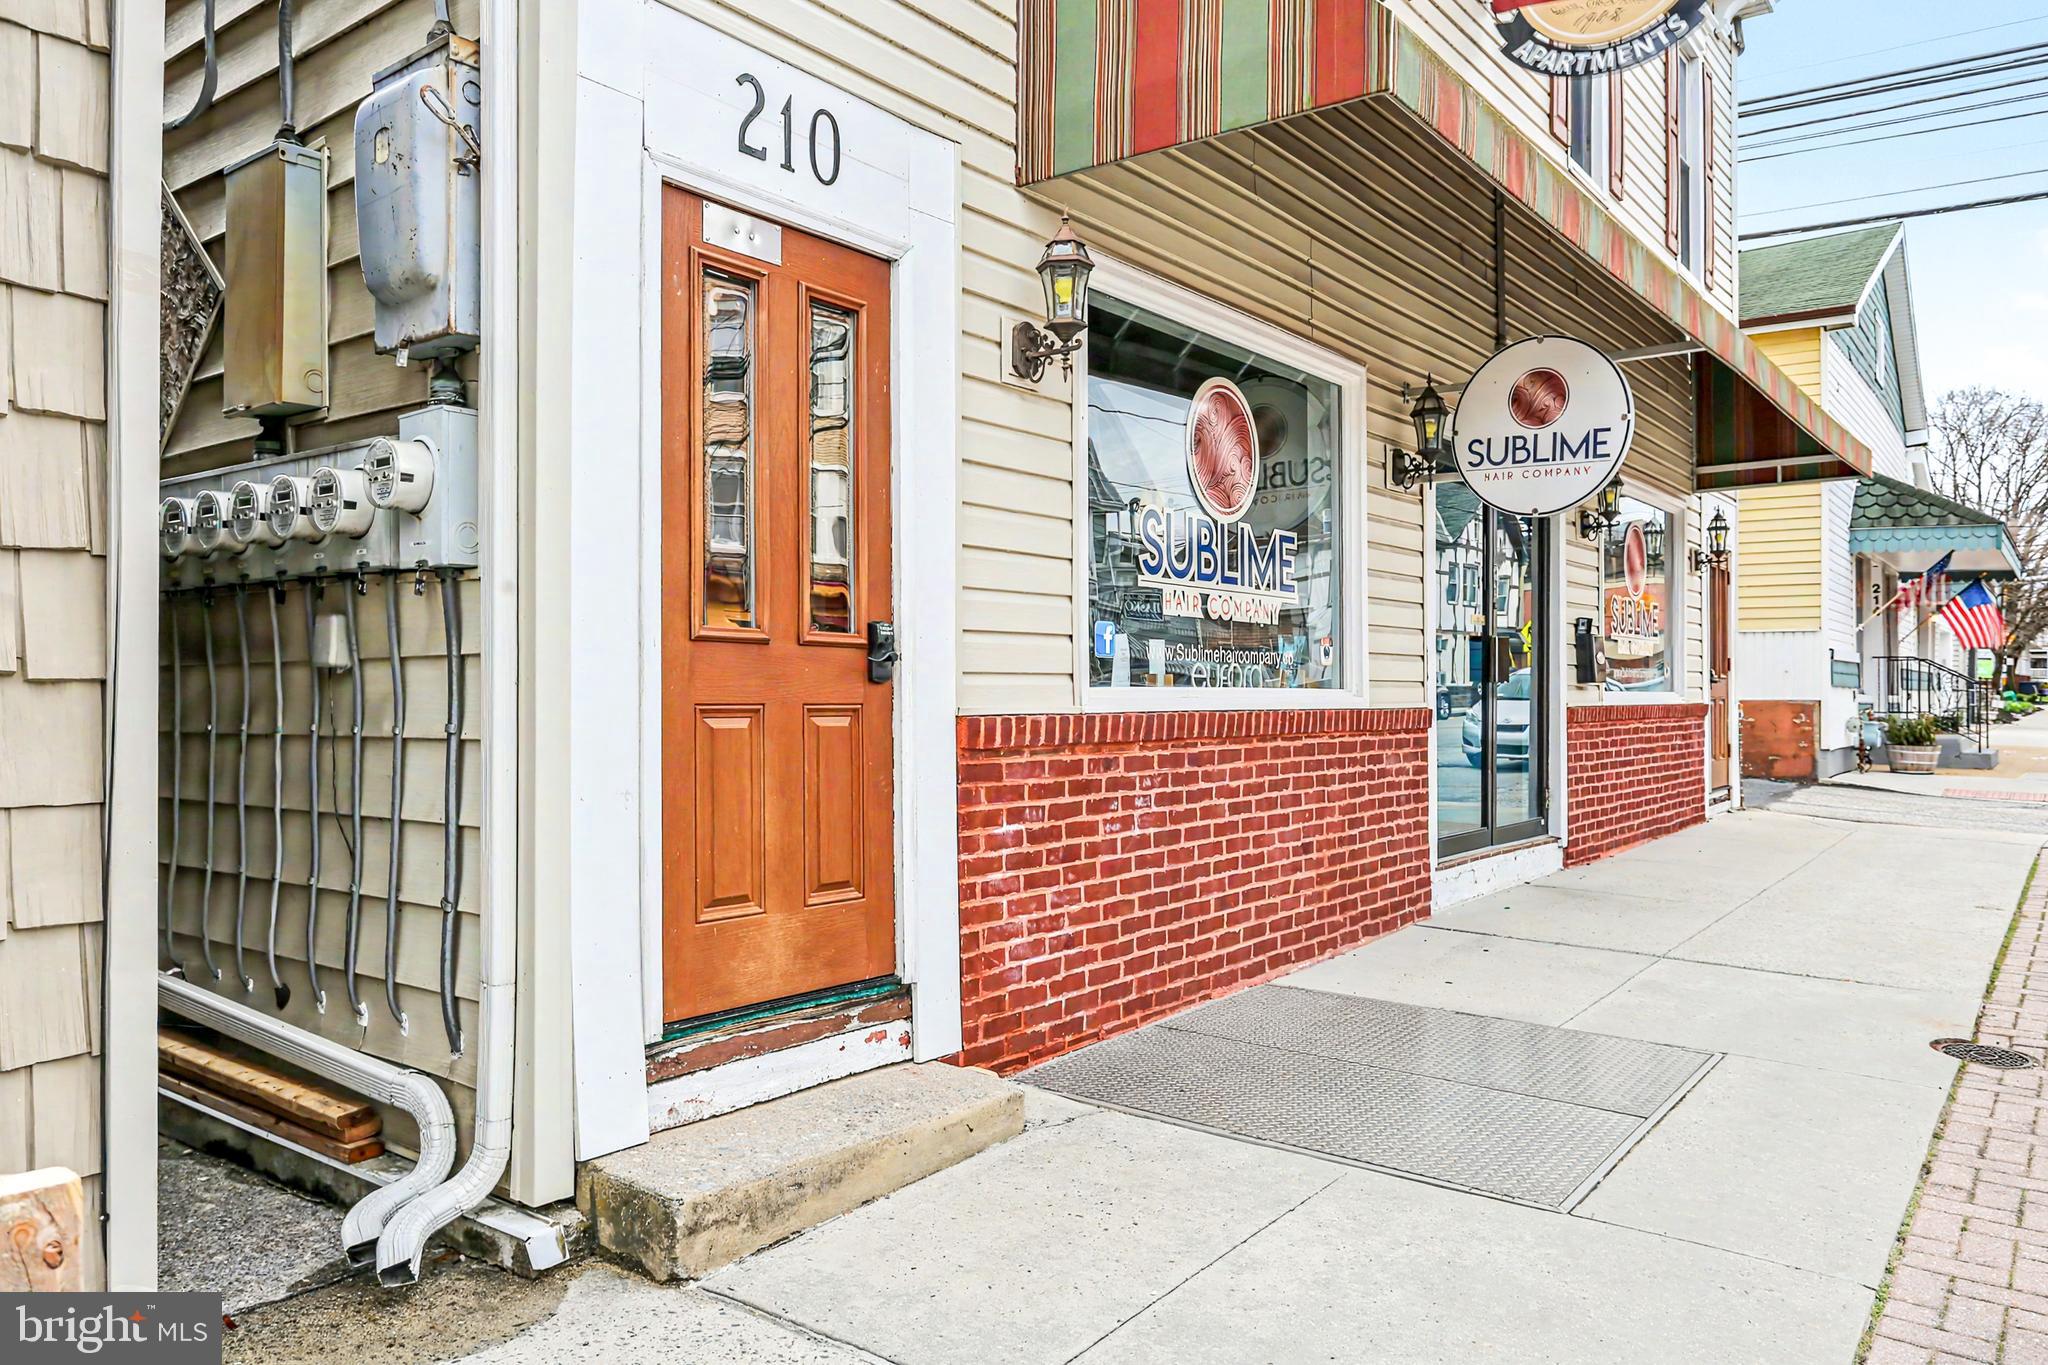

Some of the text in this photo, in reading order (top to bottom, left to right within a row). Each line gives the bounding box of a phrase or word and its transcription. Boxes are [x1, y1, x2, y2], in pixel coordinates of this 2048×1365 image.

[1512, 13, 1690, 74] APARTMENTS
[736, 73, 841, 185] 210
[1468, 427, 1612, 468] SUBLIME
[1484, 466, 1592, 482] HAIR COMPANY
[1140, 507, 1297, 593] SUBLIME
[1165, 592, 1199, 612] HAIR
[1210, 598, 1280, 621] COMPANY
[1611, 596, 1660, 638] SUBLIME
